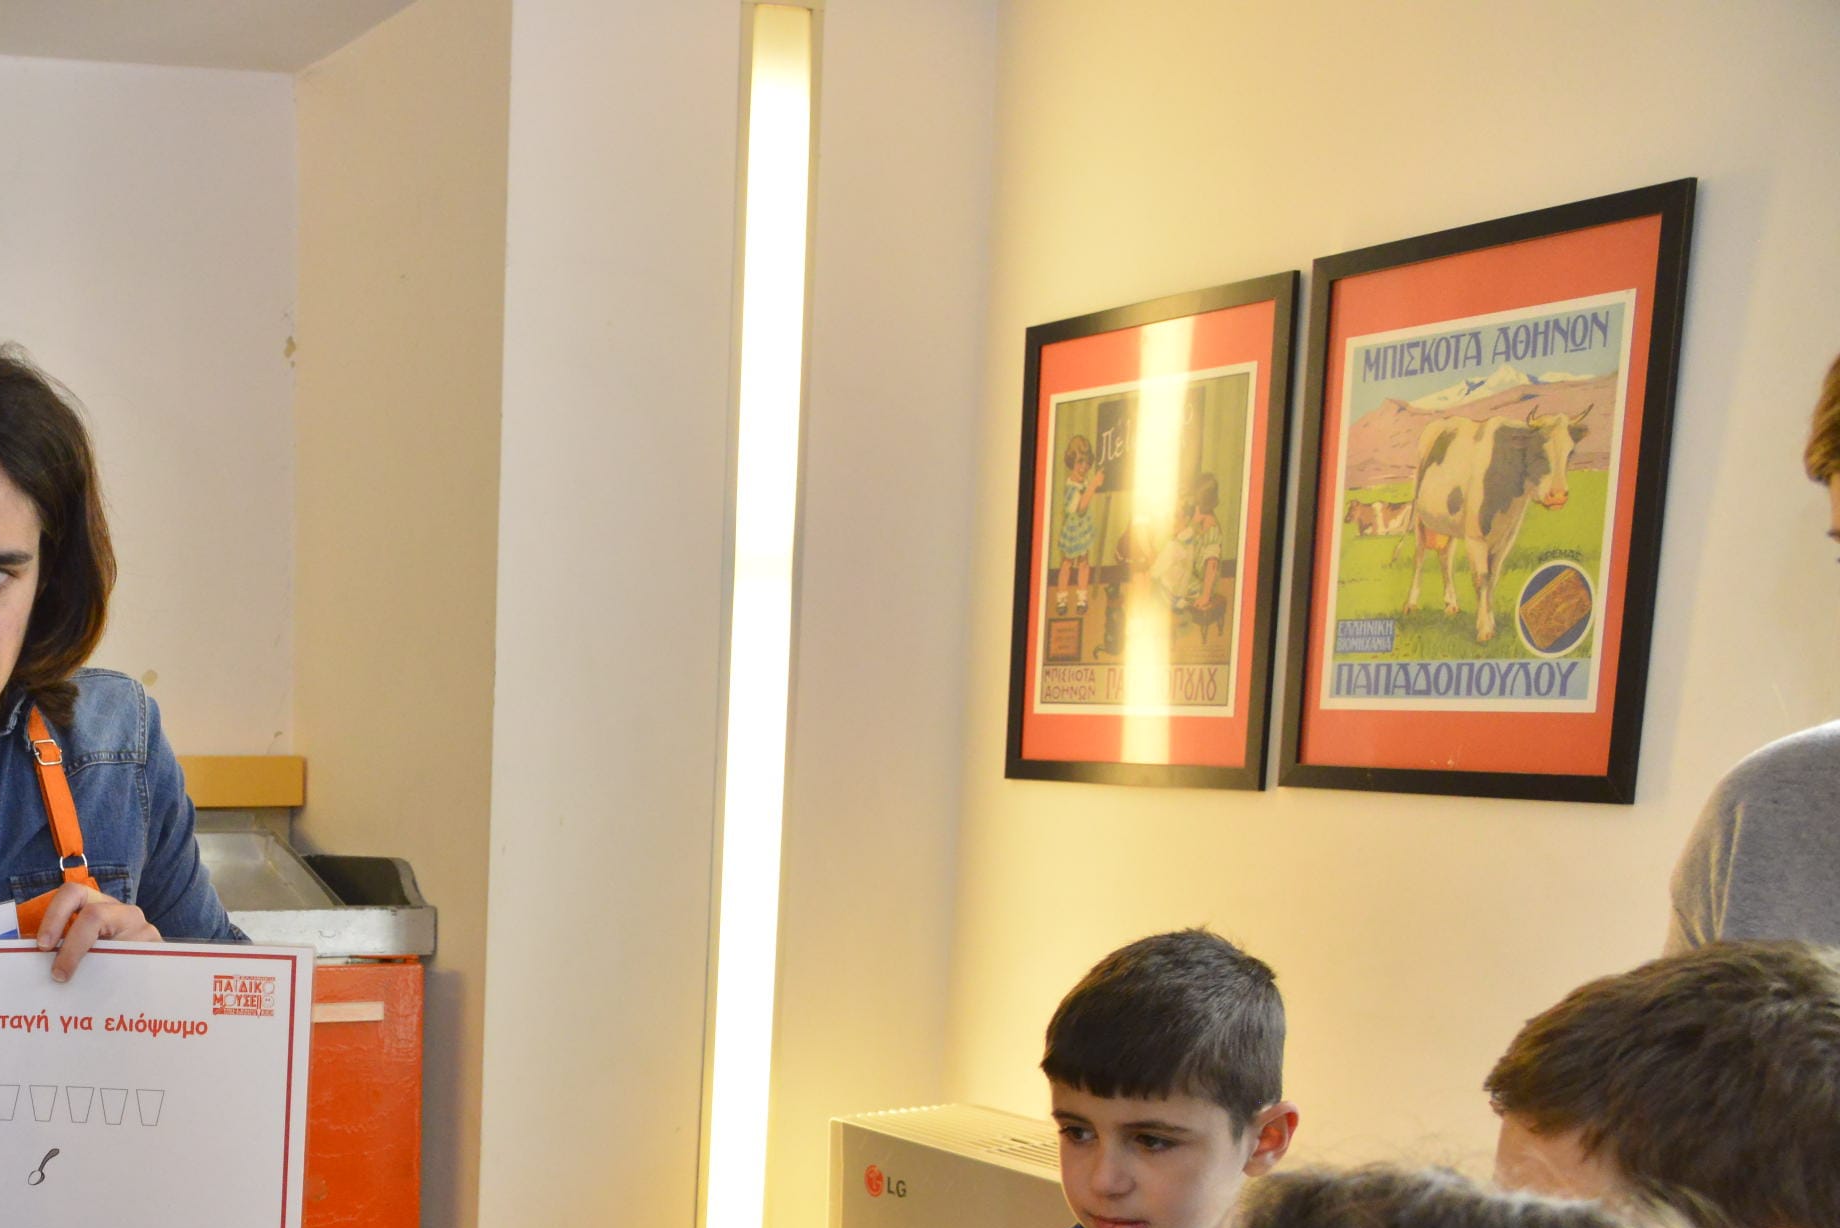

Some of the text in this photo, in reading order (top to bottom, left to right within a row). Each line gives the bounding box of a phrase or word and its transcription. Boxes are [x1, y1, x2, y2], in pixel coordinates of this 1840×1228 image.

[1362, 310, 1610, 383] ΜΠΙΣΚΟΤΑ ΑΘΗΝΩΝ
[1044, 668, 1096, 683] ΜΠΙΣΚΟΤΑ
[1335, 661, 1579, 697] ΠΑΠΑΔΟΠΟΥΛΟΥ
[60, 1014, 93, 1033] για
[104, 1013, 208, 1039] ελιόψωμο
[887, 1176, 907, 1198] LG
